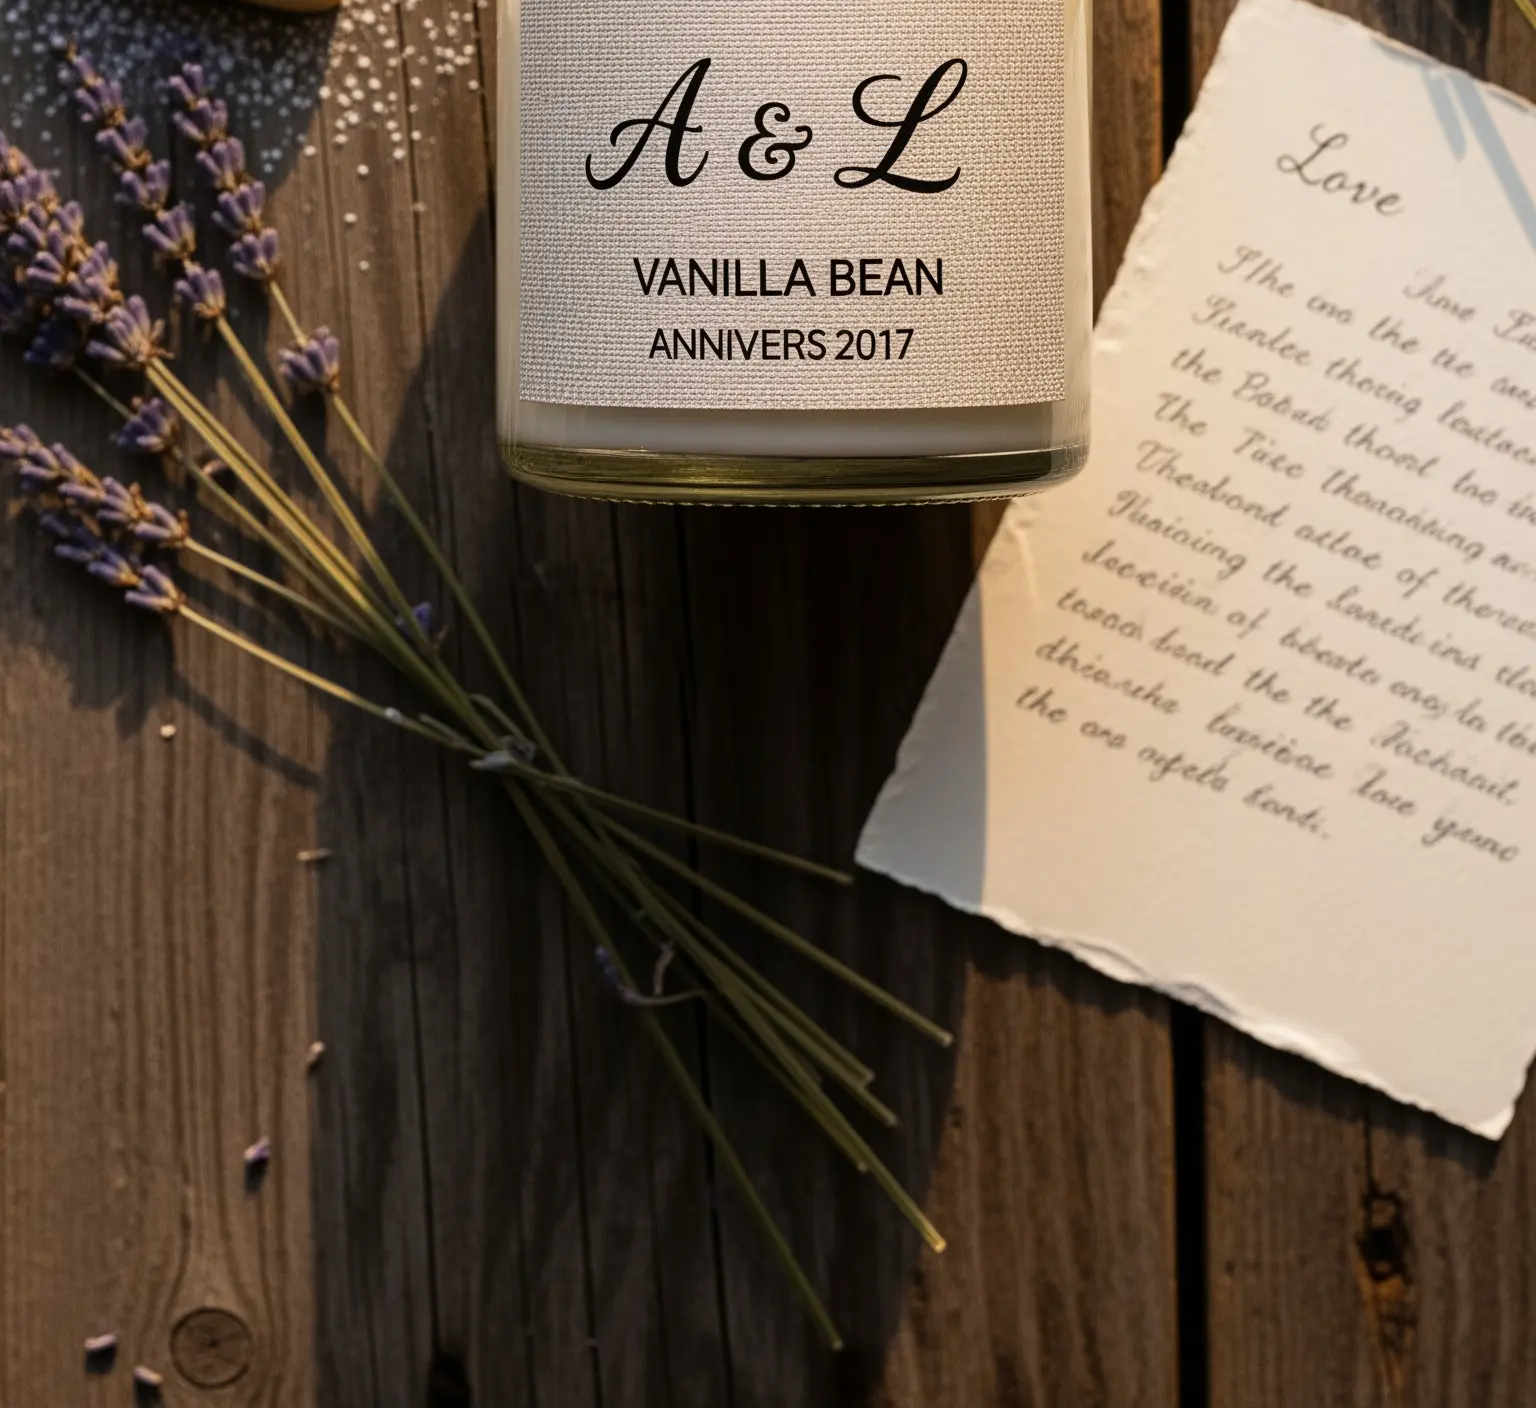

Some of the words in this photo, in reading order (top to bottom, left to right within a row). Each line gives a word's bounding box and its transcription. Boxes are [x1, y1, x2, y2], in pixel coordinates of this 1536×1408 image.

[585, 57, 712, 191] A
[737, 101, 813, 181] &
[833, 58, 968, 194] L
[1277, 124, 1404, 217] Love
[632, 257, 817, 297] VANILLA
[830, 257, 943, 297] BEAN
[648, 327, 827, 361] ANNIVERS
[834, 328, 914, 361] 2017
[1369, 316, 1421, 355] the
[1172, 348, 1222, 385] the
[1262, 560, 1314, 599] the
[1395, 566, 1439, 599] of
[1015, 685, 1068, 725] the
[1244, 666, 1292, 705] the
[1304, 693, 1354, 733] the
